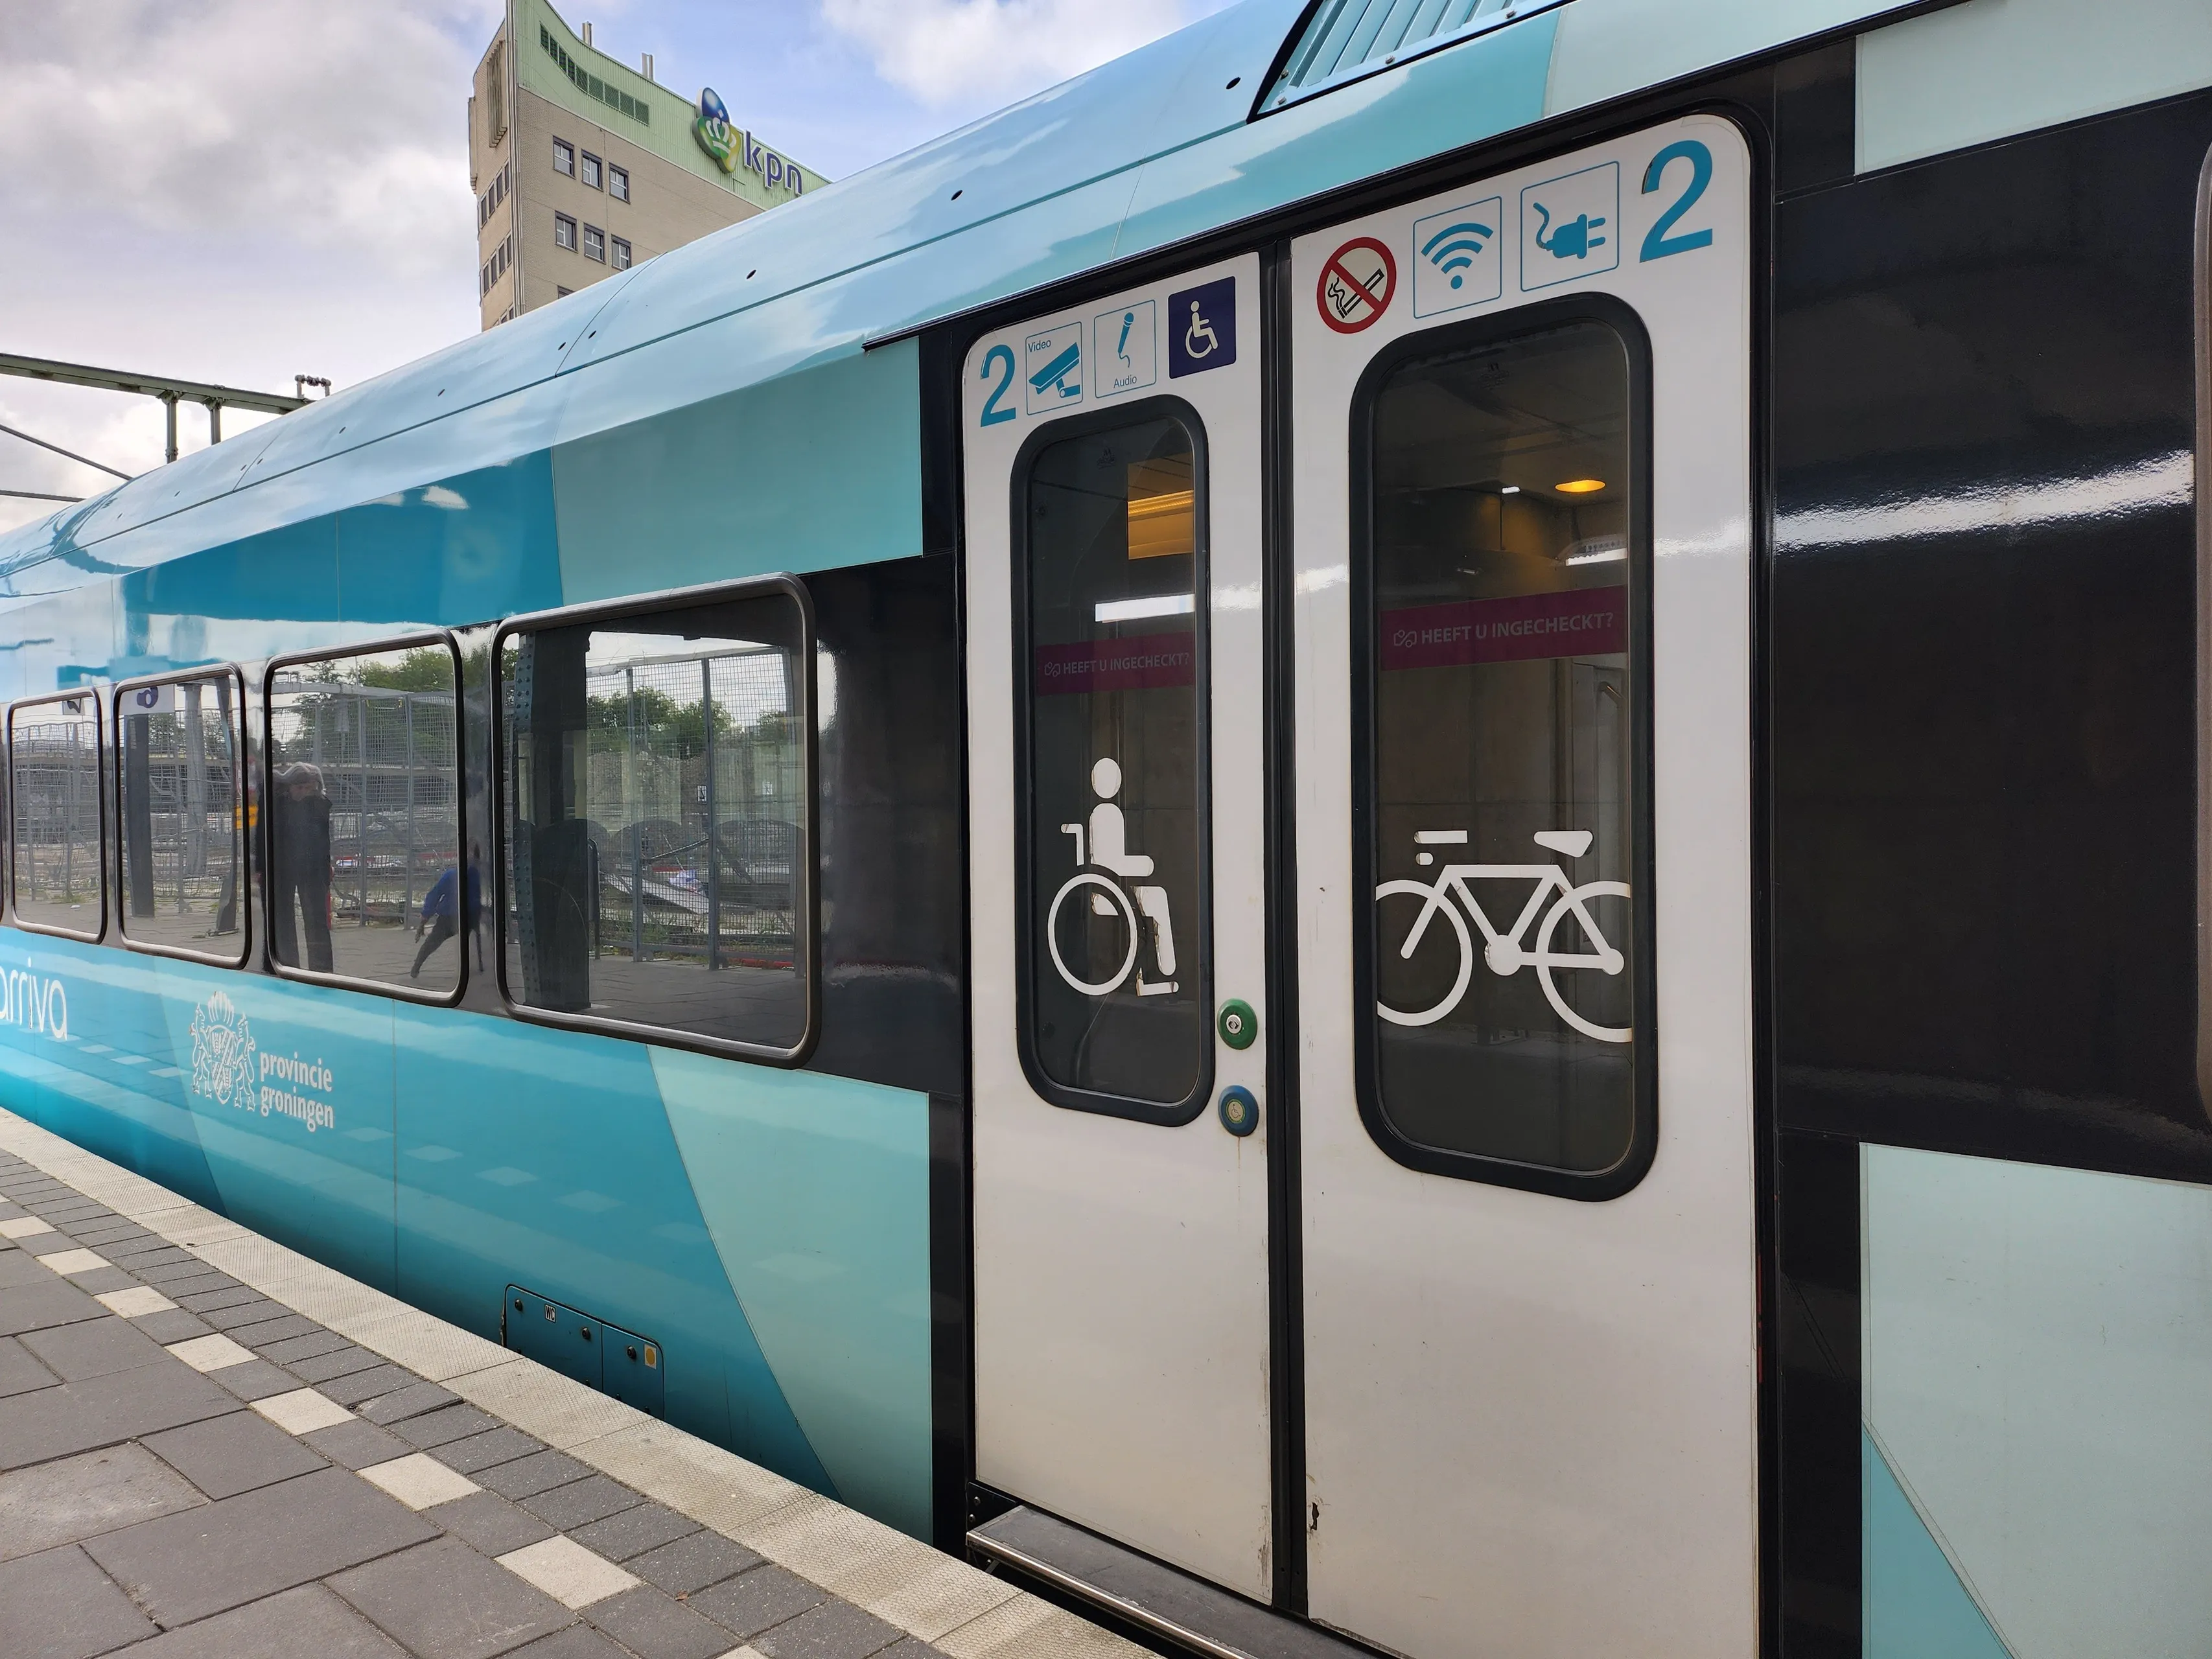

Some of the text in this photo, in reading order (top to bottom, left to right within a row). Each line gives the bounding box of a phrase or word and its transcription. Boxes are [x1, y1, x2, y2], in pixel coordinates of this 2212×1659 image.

[744, 129, 802, 196] kpn
[1639, 139, 1714, 263] 2
[1028, 338, 1051, 353] Video
[980, 344, 1016, 428] 2
[1113, 374, 1137, 389] Audio
[1421, 612, 1614, 645] HEEFT U INGECHECKT?
[1064, 652, 1190, 675] HEEFT U INGECHECKT?
[260, 1050, 332, 1093] provincie
[261, 1086, 334, 1133] groningen
[546, 1305, 555, 1321] WC
